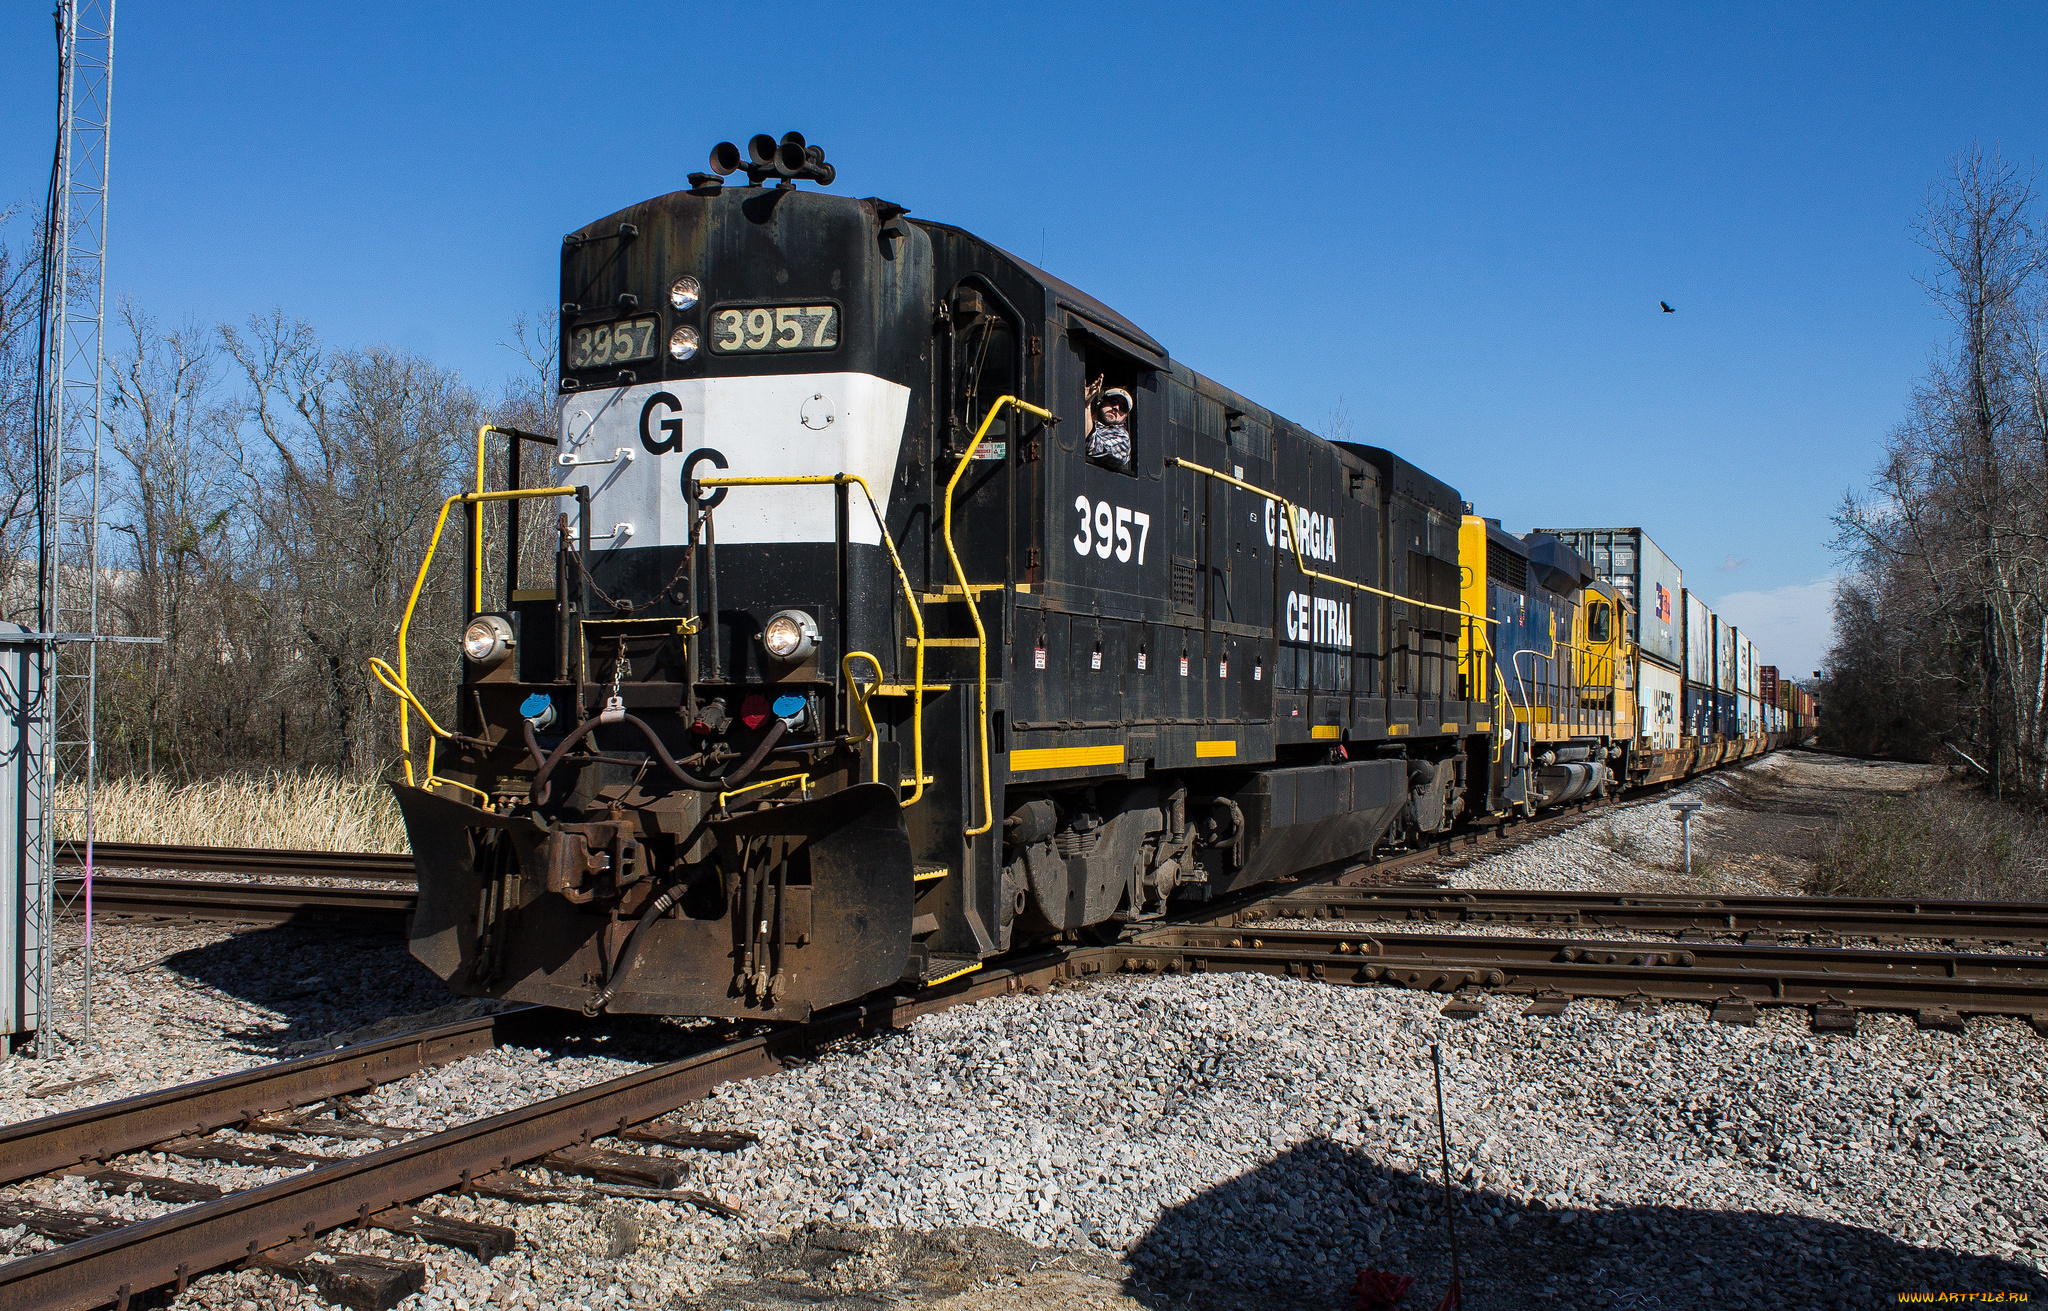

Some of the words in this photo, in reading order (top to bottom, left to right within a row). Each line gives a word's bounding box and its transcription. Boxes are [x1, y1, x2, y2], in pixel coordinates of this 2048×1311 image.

[575, 319, 655, 368] 3957
[718, 305, 838, 351] 3957
[639, 391, 684, 456] G
[680, 447, 729, 511] C
[1072, 495, 1150, 566] 3957
